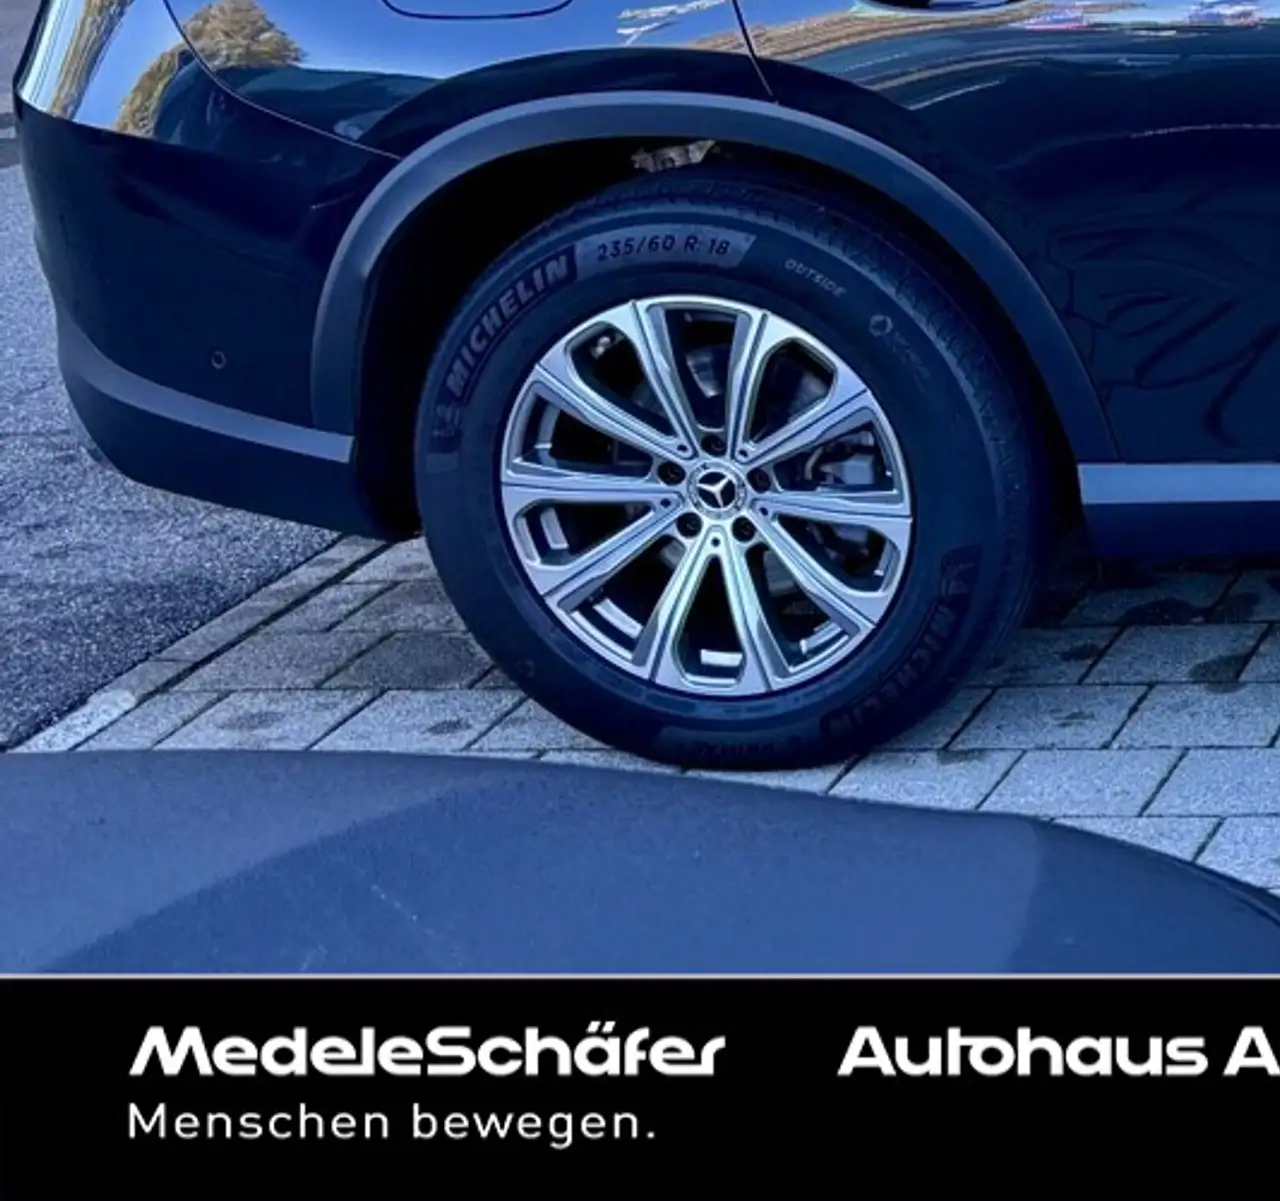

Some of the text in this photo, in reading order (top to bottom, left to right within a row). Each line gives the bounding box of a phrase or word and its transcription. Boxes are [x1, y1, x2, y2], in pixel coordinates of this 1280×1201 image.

[597, 235, 731, 261] 235/60 R 18
[785, 259, 847, 298] OUTSIDE
[446, 255, 568, 397] MICHELIN
